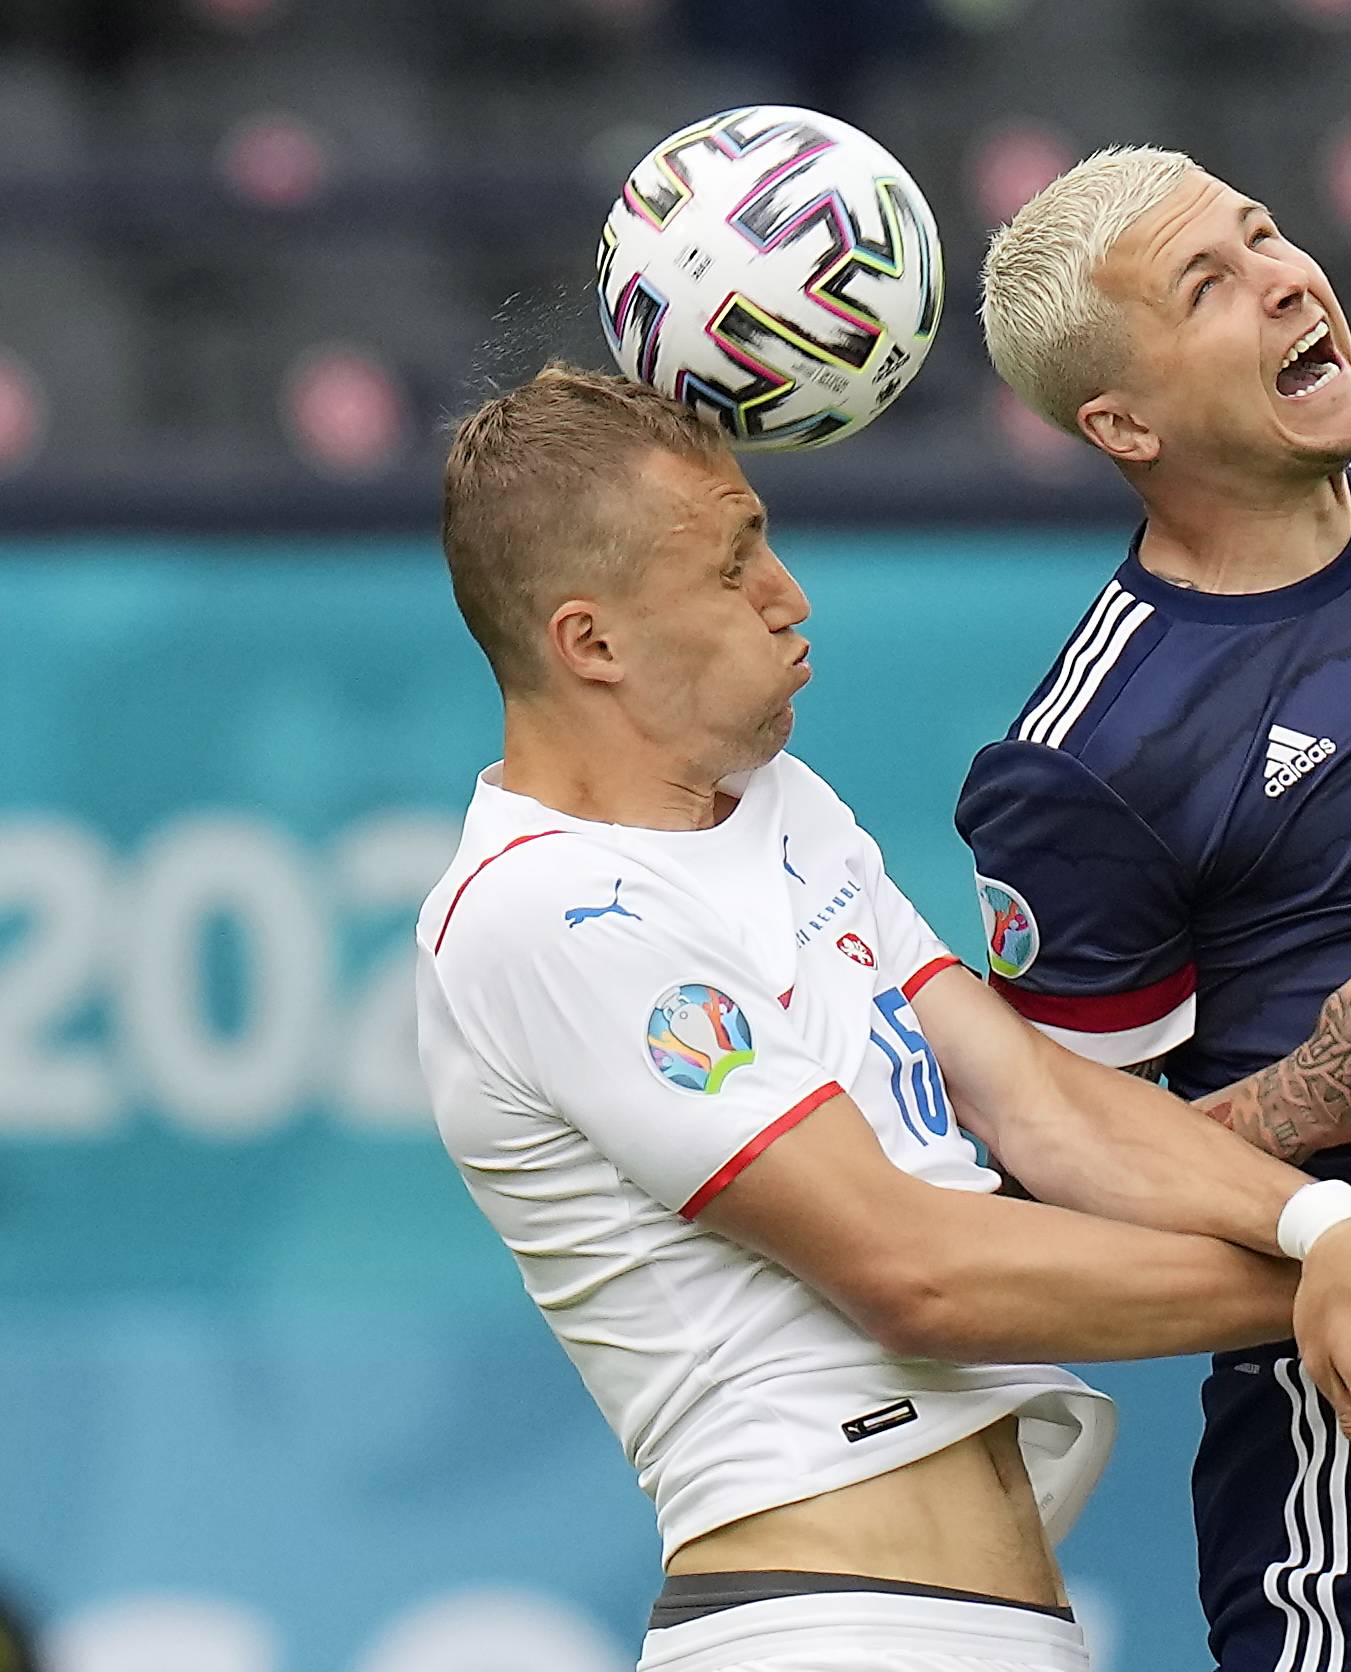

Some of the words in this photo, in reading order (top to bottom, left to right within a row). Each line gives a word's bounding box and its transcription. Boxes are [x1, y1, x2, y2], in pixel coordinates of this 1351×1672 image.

[1264, 737, 1337, 798] adidas
[809, 880, 861, 931] REPUBL
[0, 812, 462, 1142] 202
